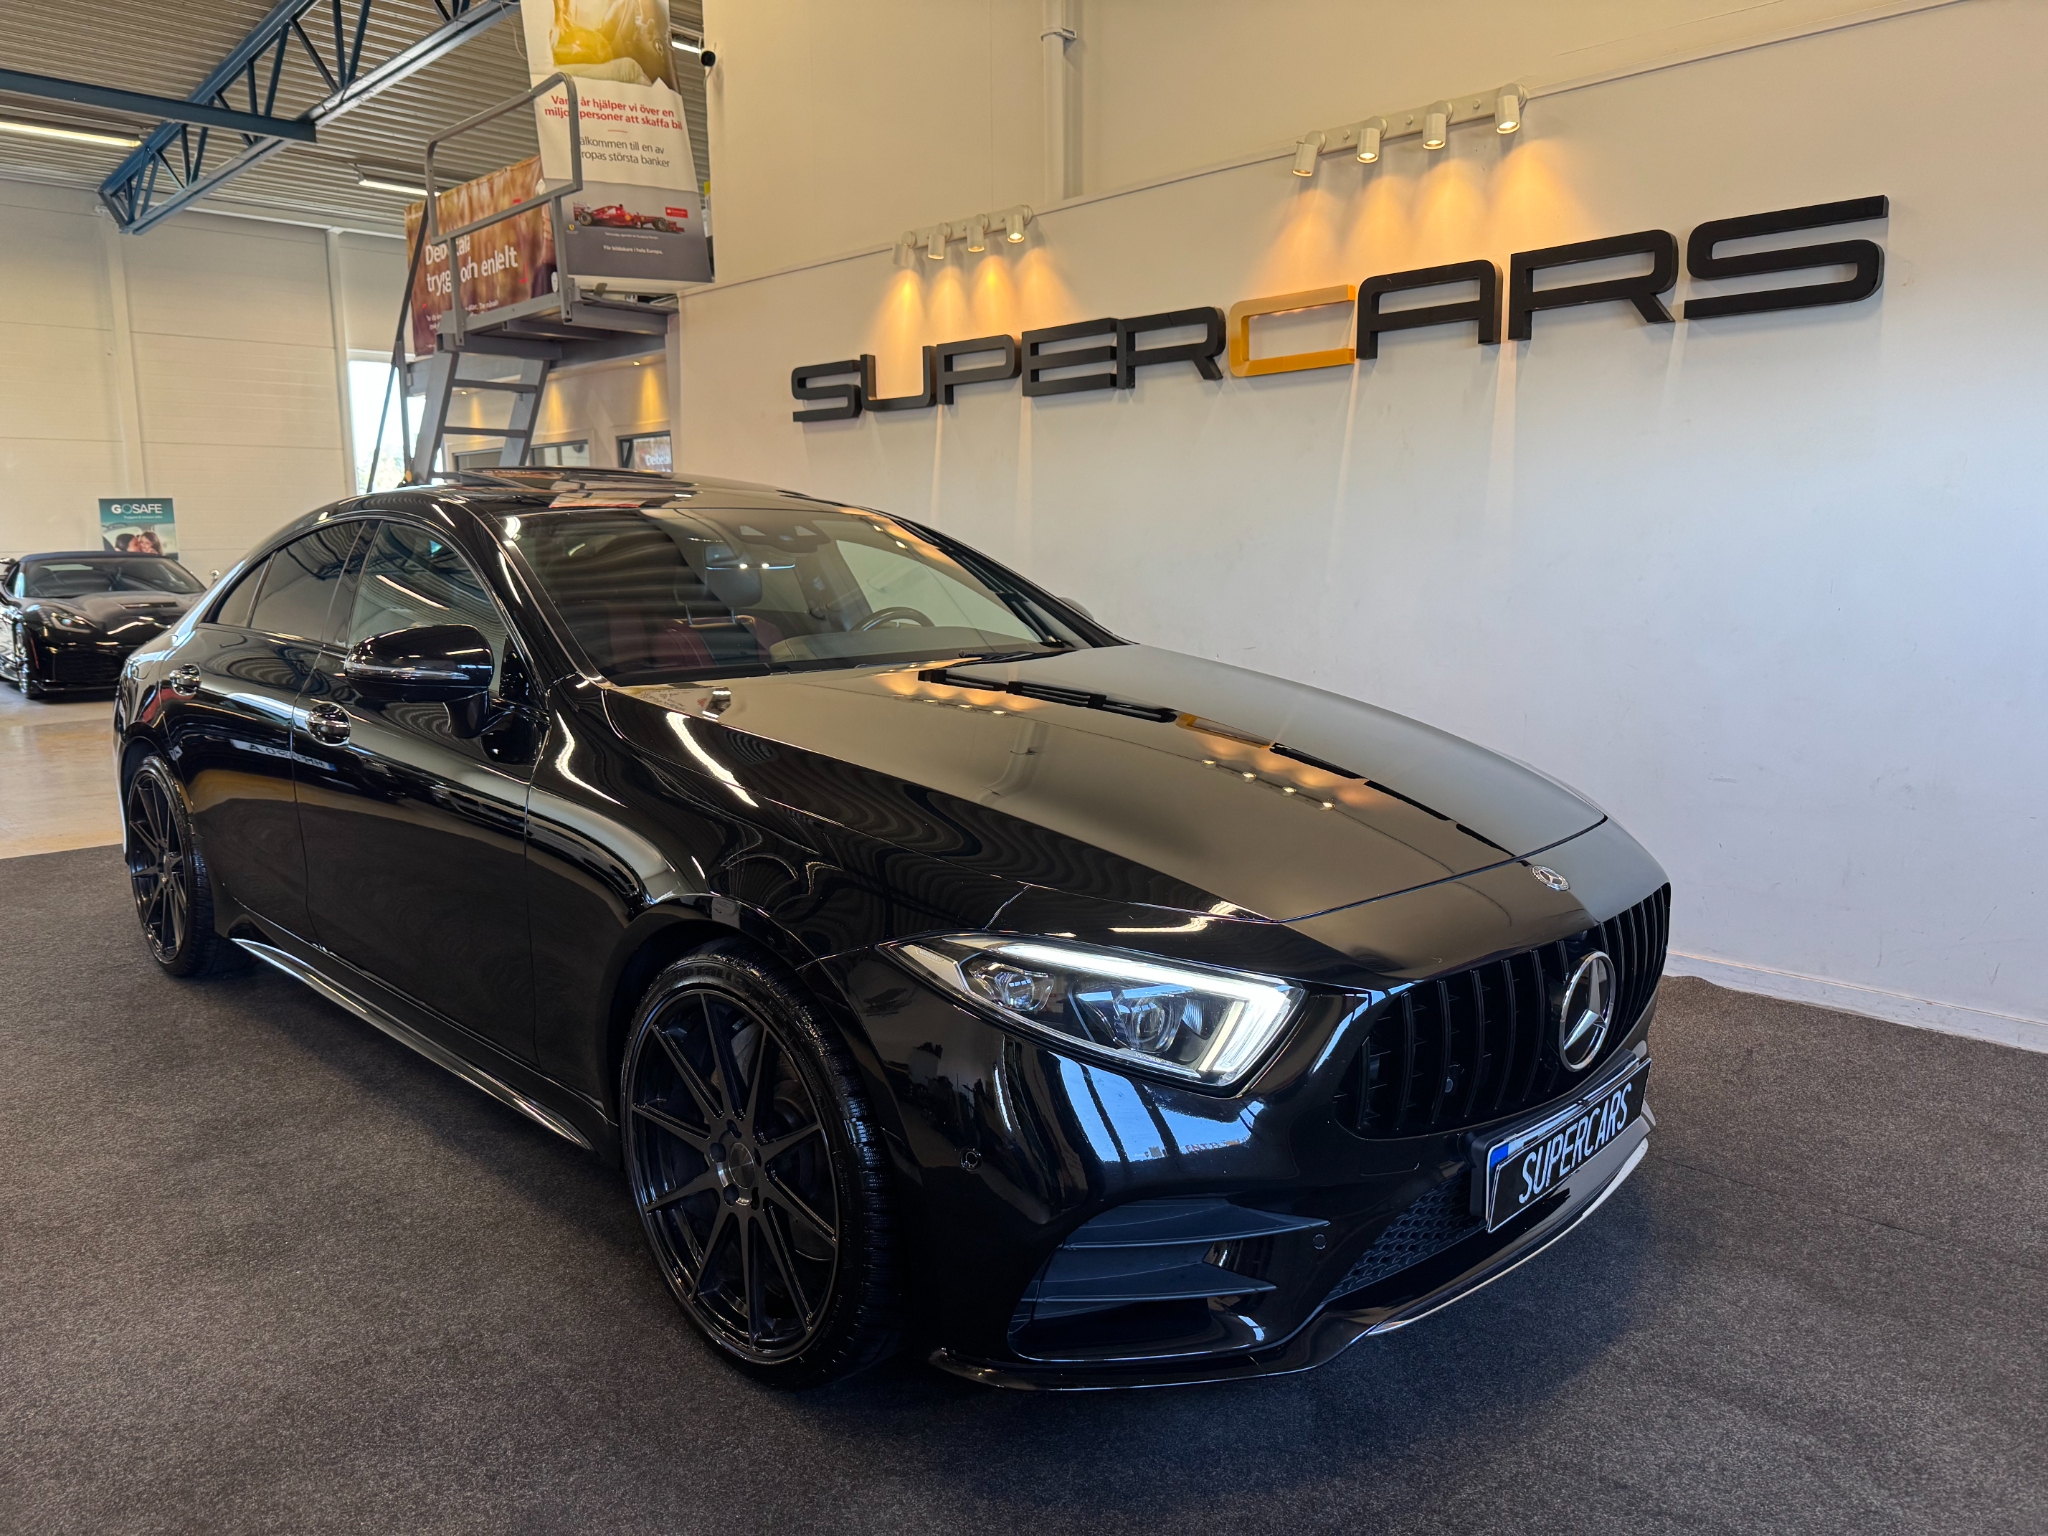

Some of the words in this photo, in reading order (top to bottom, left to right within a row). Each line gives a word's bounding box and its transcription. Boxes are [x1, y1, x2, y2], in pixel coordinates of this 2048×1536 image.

[580, 97, 590, 107] år
[594, 98, 626, 112] hjälper
[629, 103, 638, 112] vi
[640, 103, 660, 116] över
[662, 109, 674, 118] en
[544, 108, 570, 119] miljo
[580, 111, 623, 122] personer
[626, 114, 640, 124] att
[642, 116, 669, 129] skaffa
[672, 119, 682, 130] bil
[580, 136, 628, 150] älkommen
[630, 141, 640, 151] till
[642, 143, 652, 152] en
[655, 146, 664, 154] av
[582, 152, 606, 162] ropas
[609, 152, 638, 164] största
[641, 155, 670, 167] banker
[791, 194, 1889, 423] SUPERCARS
[111, 503, 163, 514] GOSAFE
[1518, 1082, 1632, 1204] SUPERCARS
